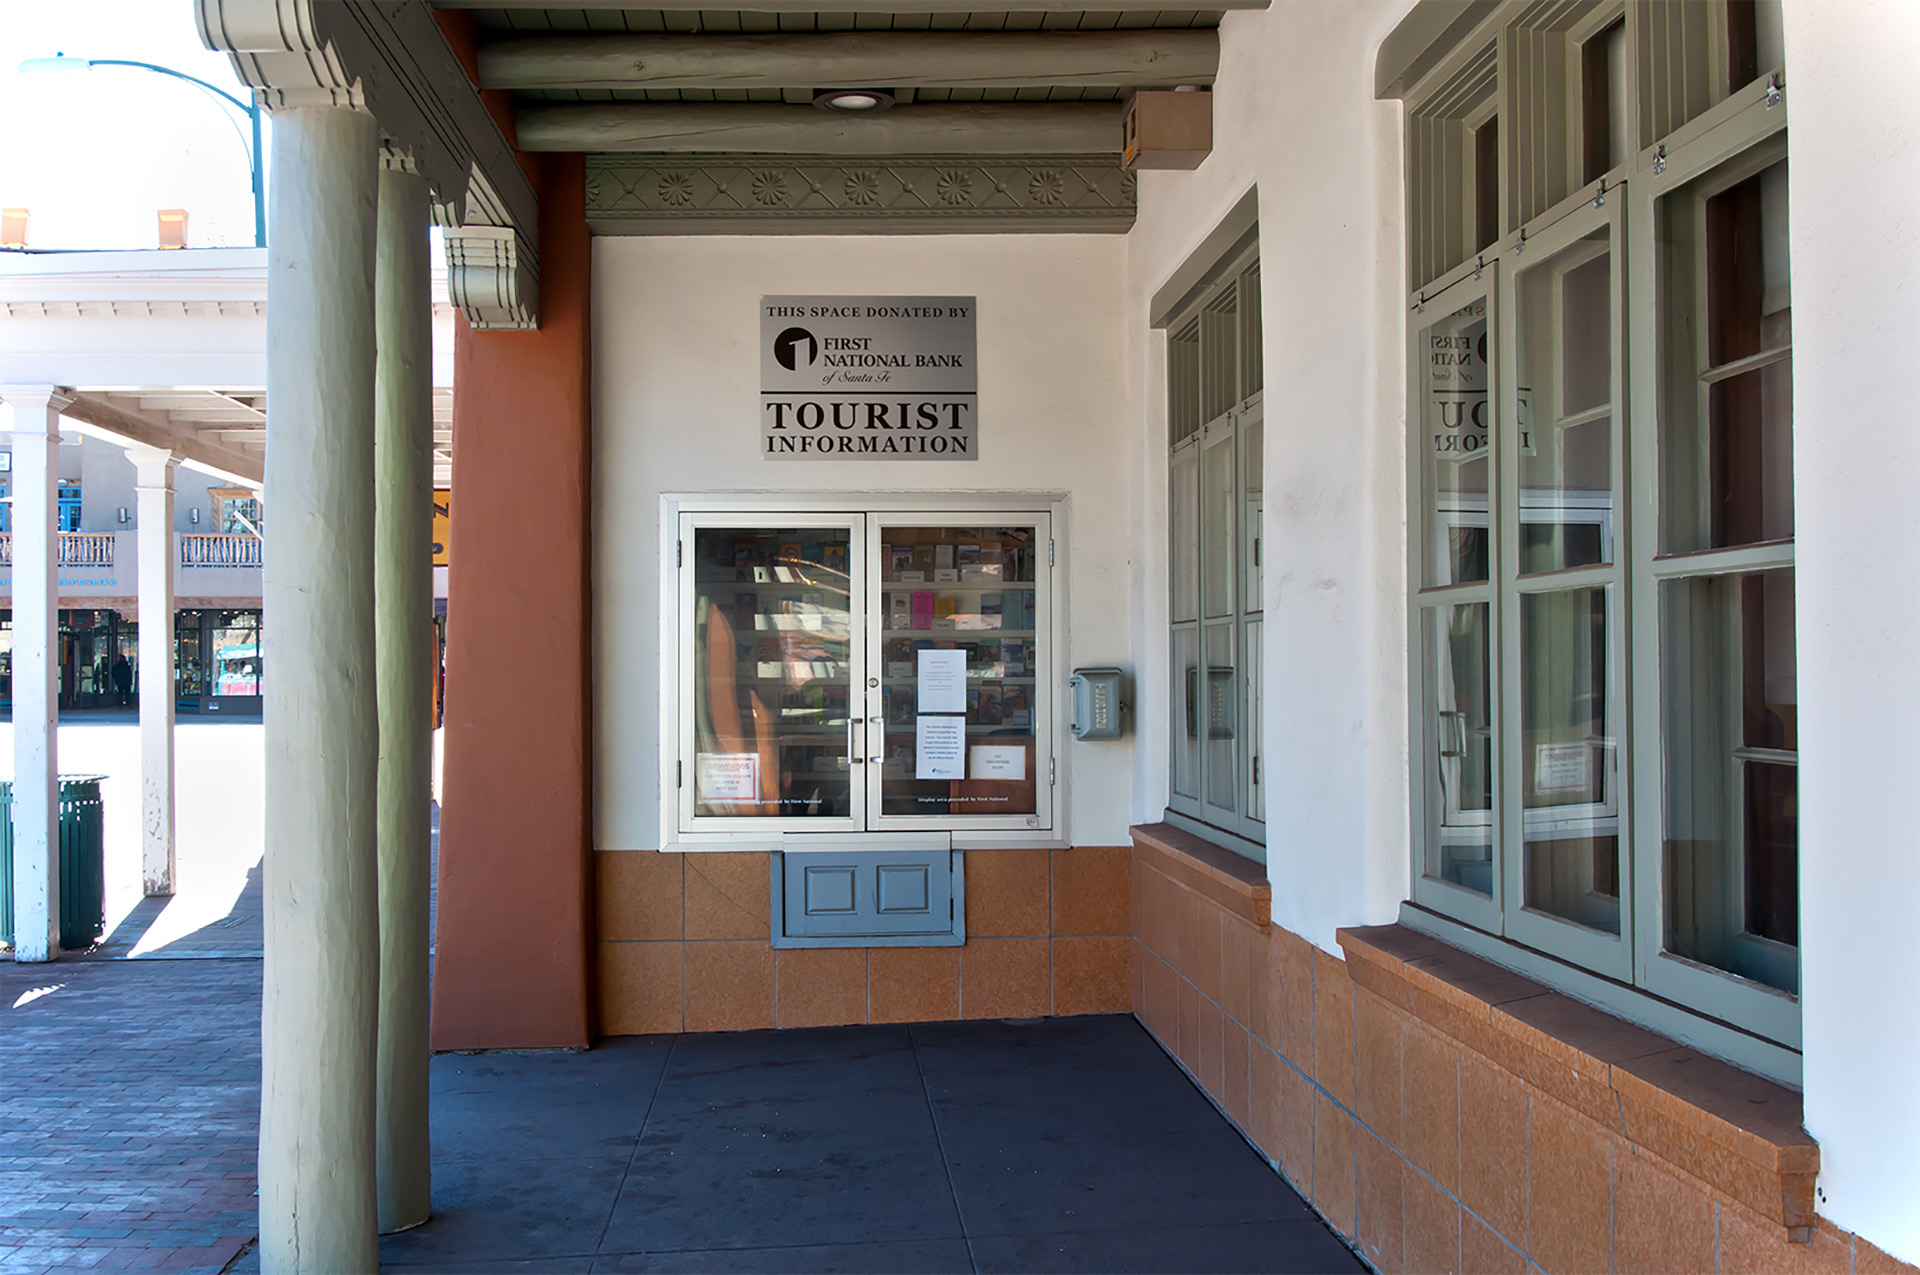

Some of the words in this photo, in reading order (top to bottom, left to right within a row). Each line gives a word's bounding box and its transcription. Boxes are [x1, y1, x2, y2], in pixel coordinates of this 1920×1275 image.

[766, 306, 806, 318] THIS
[810, 306, 861, 318] SPACE
[866, 306, 943, 319] DONATED
[949, 307, 969, 319] BY
[823, 337, 872, 351] FIRST
[823, 354, 911, 368] NATIONAL
[915, 354, 964, 368] BANK
[822, 371, 837, 386] of
[838, 370, 873, 383] Santa
[874, 370, 892, 383] Fe
[766, 402, 969, 431] TOURIST
[766, 435, 969, 454] INFORMATION
[58, 577, 118, 587] Arcade
